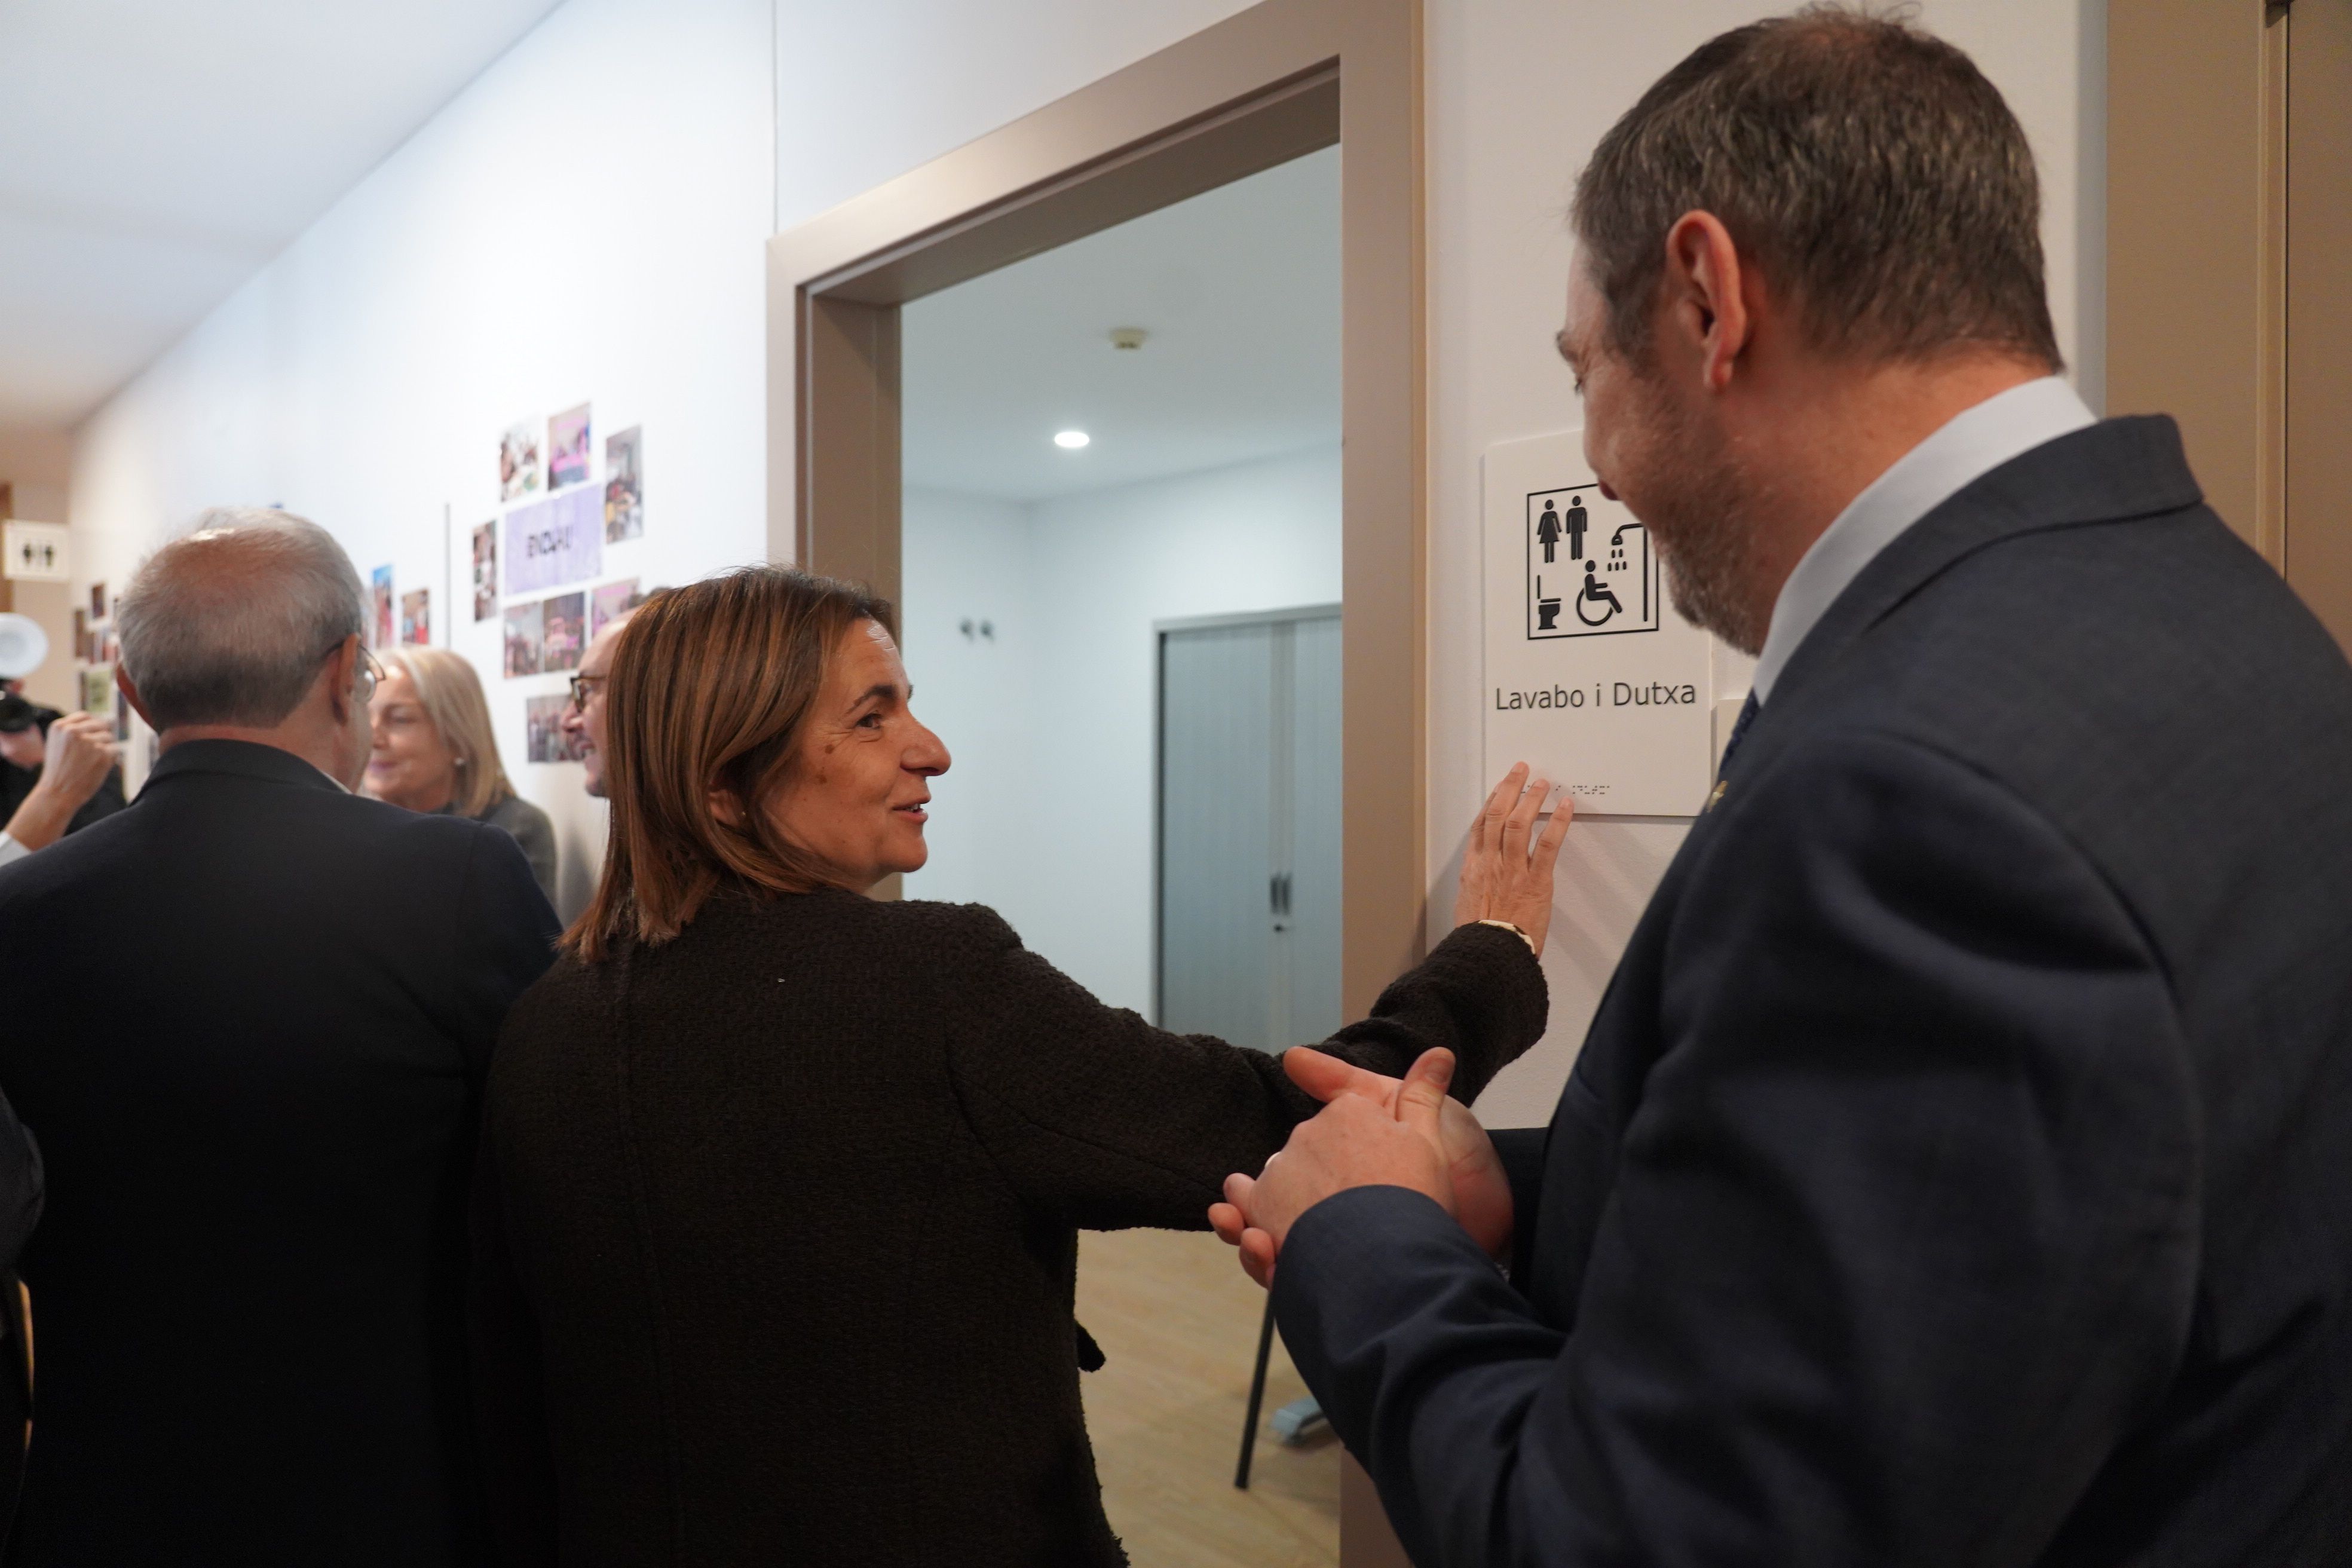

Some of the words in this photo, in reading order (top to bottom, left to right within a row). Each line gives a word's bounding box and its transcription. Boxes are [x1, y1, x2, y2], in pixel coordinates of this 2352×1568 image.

[1496, 684, 1585, 710] Lavabo
[1596, 682, 1601, 707] i
[1613, 681, 1696, 706] Dutxa
